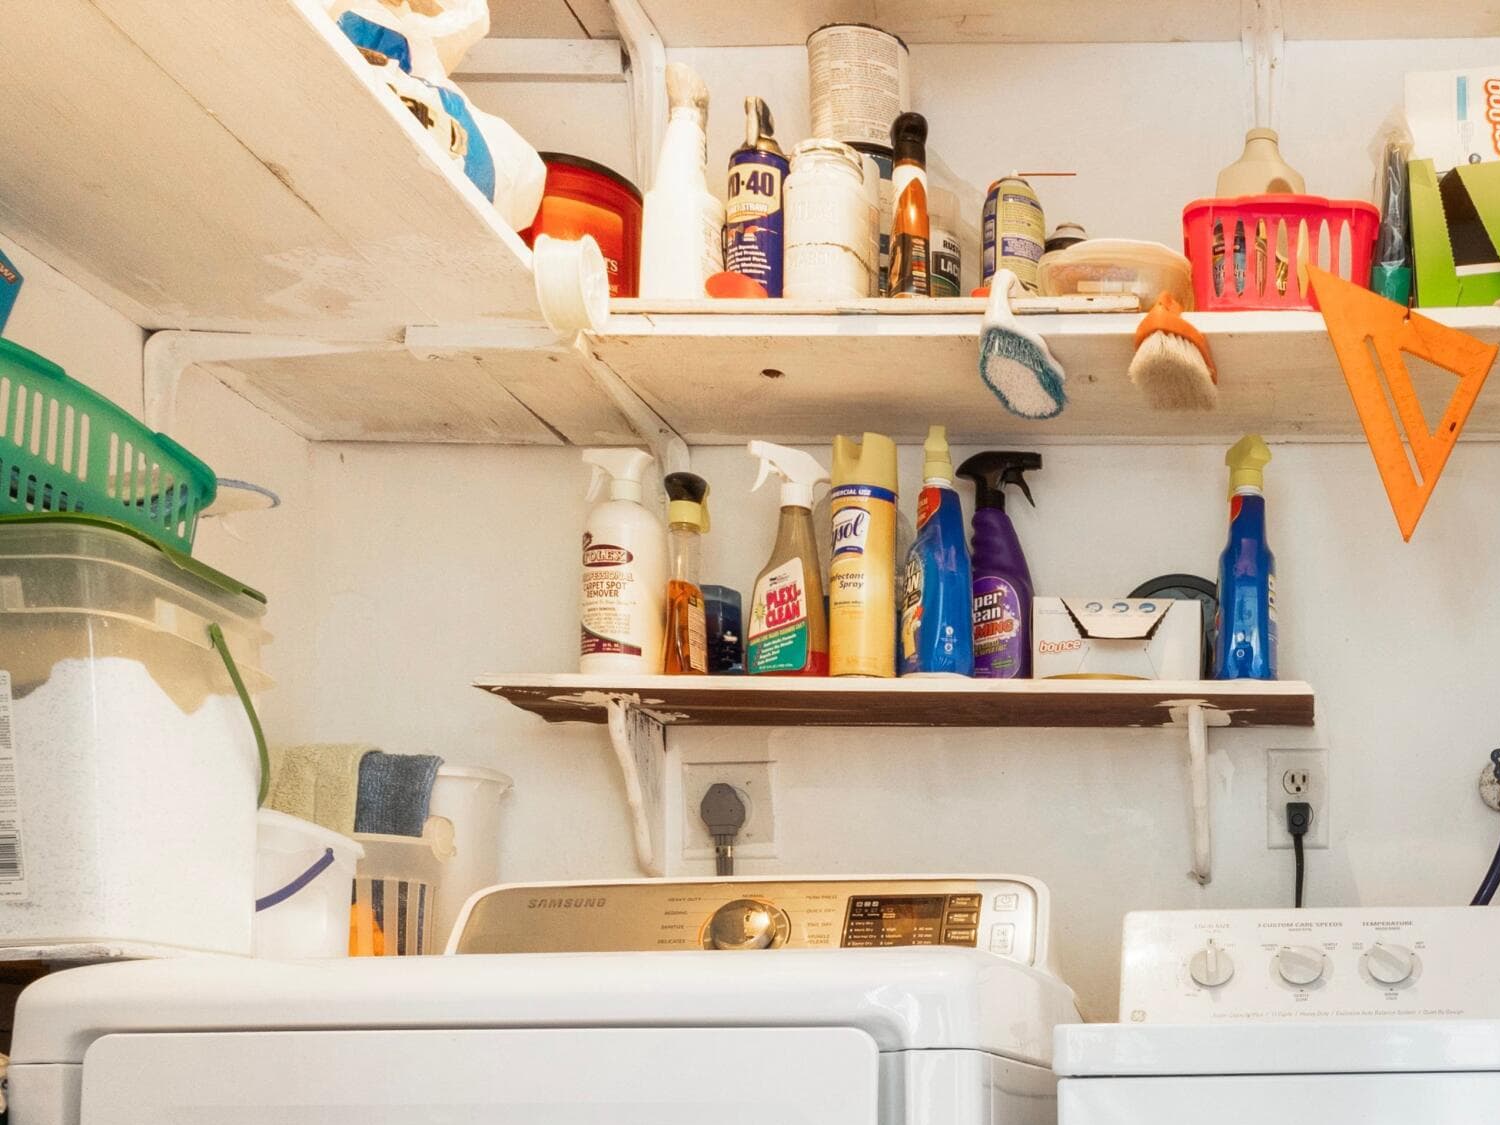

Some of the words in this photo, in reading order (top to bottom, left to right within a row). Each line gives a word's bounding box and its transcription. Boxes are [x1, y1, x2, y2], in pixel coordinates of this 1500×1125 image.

[840, 580, 864, 589] Spray
[587, 590, 619, 598] REMOVER
[974, 592, 1003, 611] per
[766, 601, 801, 628] CLEAN
[974, 607, 1001, 623] ean
[975, 619, 1014, 638] MING
[1038, 639, 1082, 654] bounce
[528, 897, 607, 909] SAMSUNG
